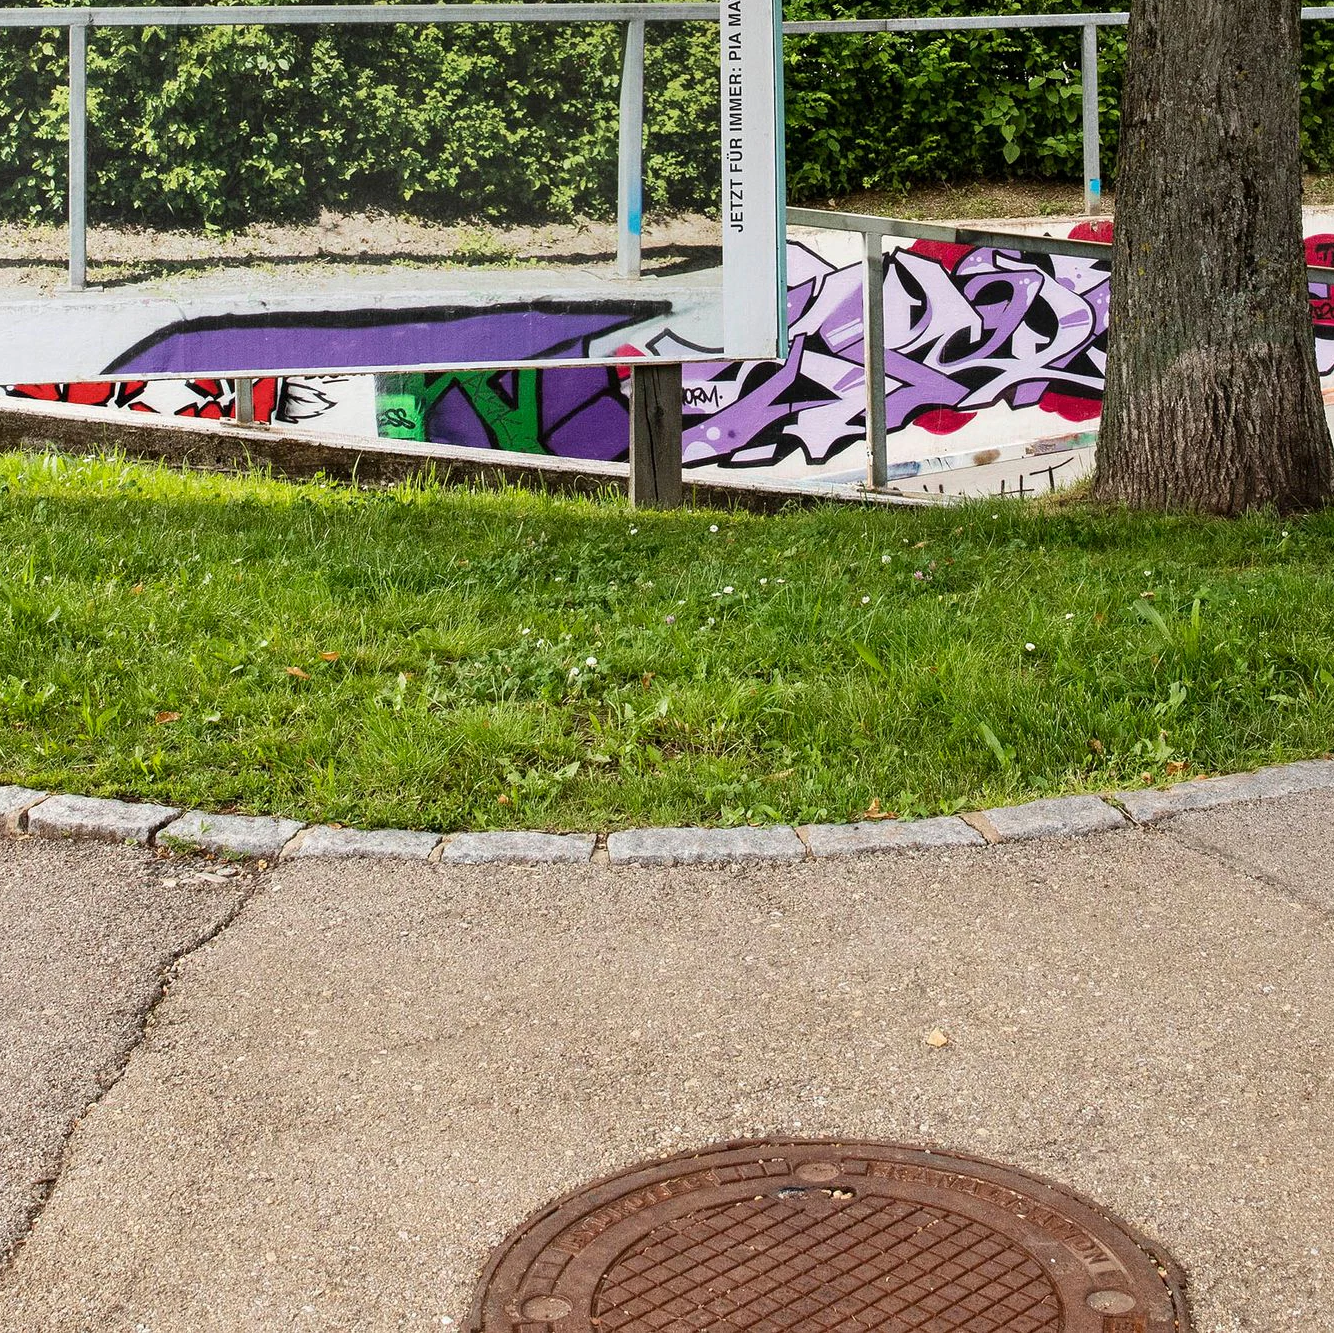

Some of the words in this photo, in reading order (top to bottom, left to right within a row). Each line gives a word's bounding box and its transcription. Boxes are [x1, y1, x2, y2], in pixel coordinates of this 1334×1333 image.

[728, 32, 742, 61] PIA
[729, 68, 743, 132] IMMER:
[726, 138, 743, 171] FÜR
[730, 179, 744, 233] JETZT
